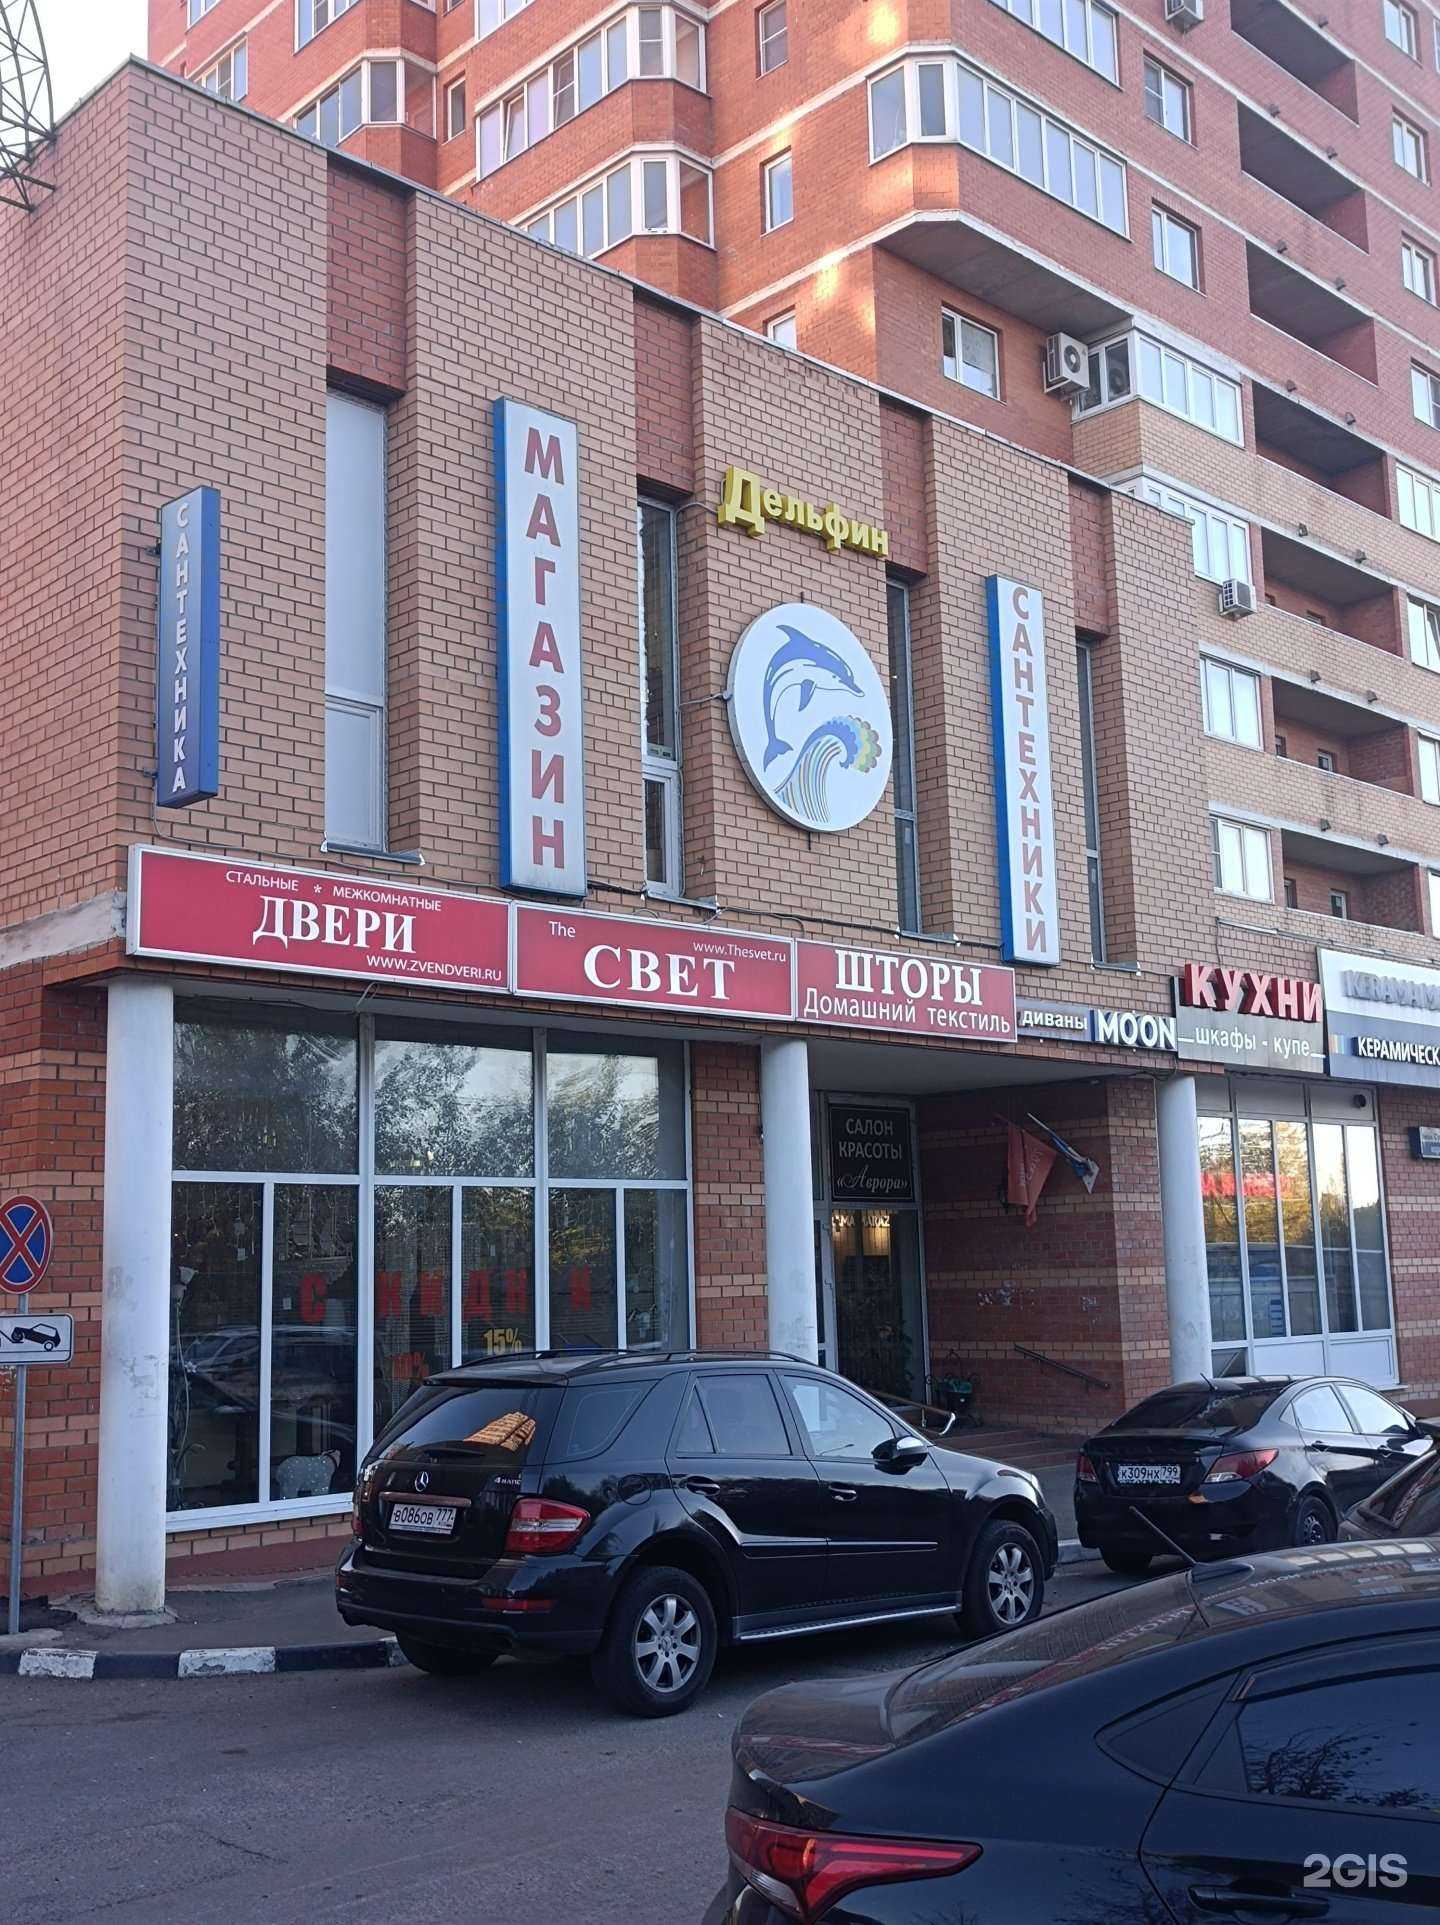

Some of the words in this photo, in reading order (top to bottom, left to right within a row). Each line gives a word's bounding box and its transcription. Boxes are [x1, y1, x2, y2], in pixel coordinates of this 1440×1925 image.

[718, 464, 889, 558] Дельфин
[171, 502, 190, 793] САНТЕХНИКА
[524, 426, 565, 869] МАГАЗИН
[1012, 586, 1048, 954] САНТЕХНИКИ
[225, 869, 300, 893] СТАЛЬНЫЕ
[332, 885, 443, 913] МЕЖКОМНАТНЫЕ
[251, 895, 417, 955] ДВЕРИ
[548, 920, 577, 939] The
[366, 954, 503, 982] WWW.ZVENDVERI.RU
[583, 943, 736, 1001] СВЕТ
[692, 940, 787, 963] www.Thesvet.ru
[834, 948, 983, 1007] ШТОРЫ
[1185, 961, 1323, 1023] КУХНИ
[803, 986, 917, 1024] Домашний
[927, 1006, 1011, 1034] текстиль
[1021, 1009, 1089, 1031] диваны
[1097, 1008, 1177, 1051] MOON
[1195, 1026, 1257, 1053] шкафы
[1273, 1036, 1311, 1059] купе
[845, 1117, 893, 1136] САЛОН
[838, 1140, 902, 1160] КРАСОТЫ
